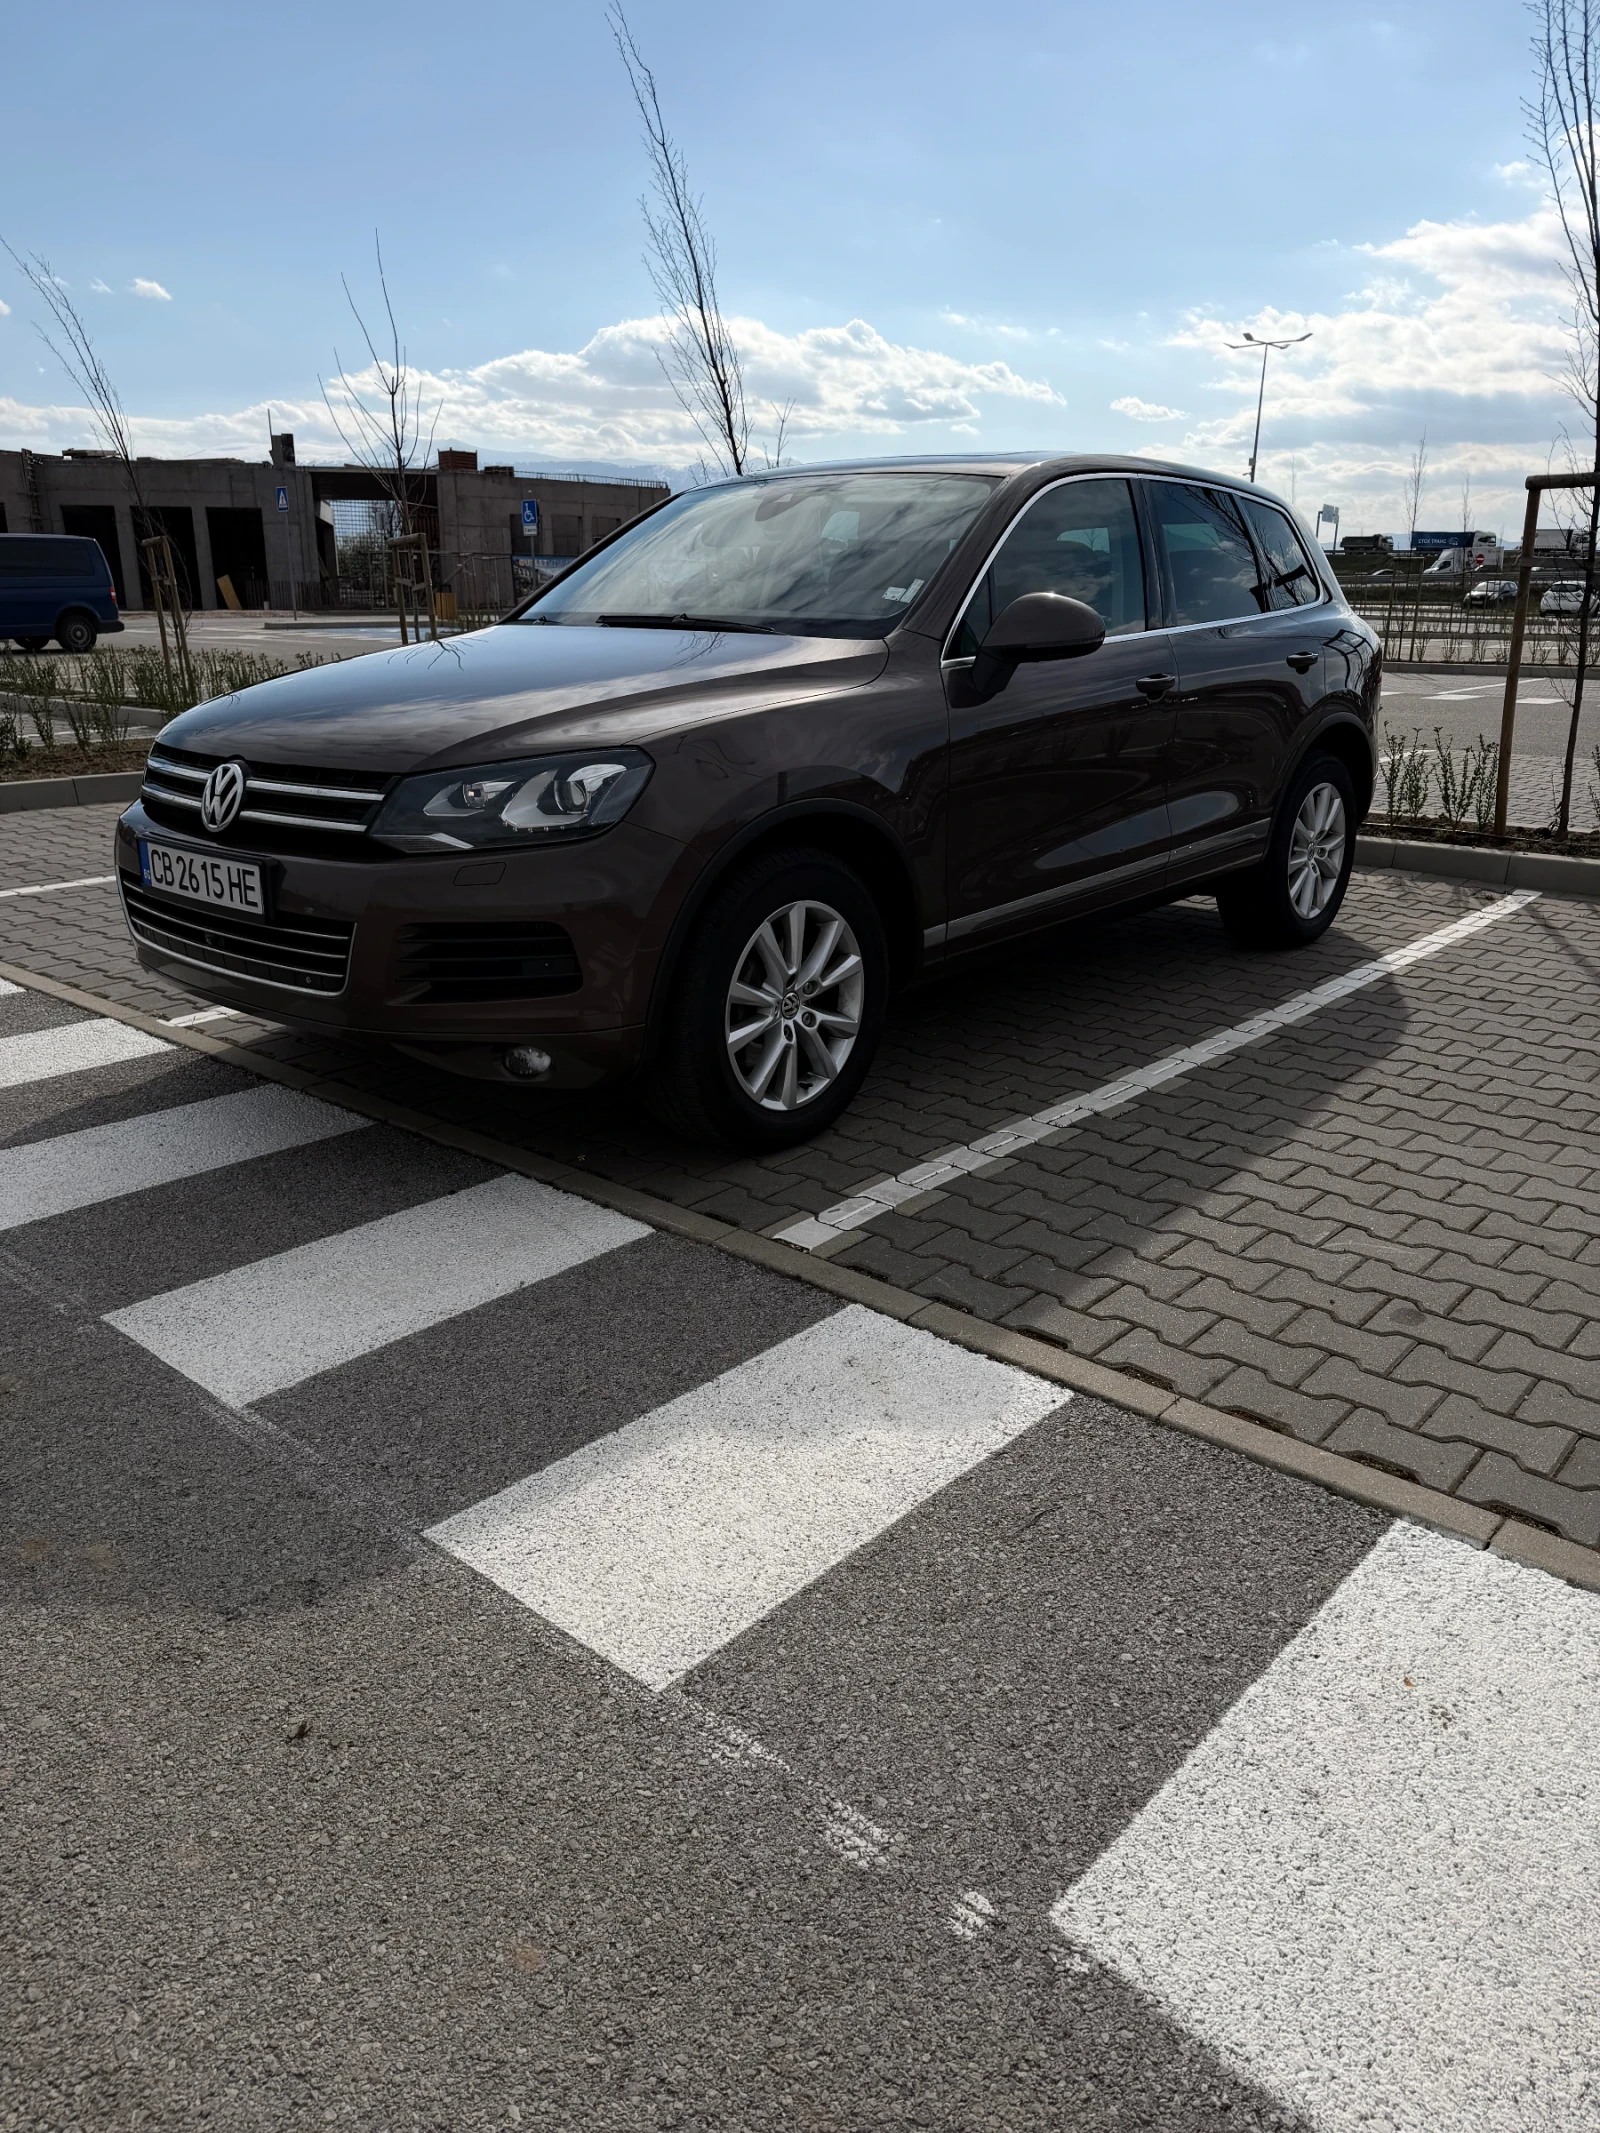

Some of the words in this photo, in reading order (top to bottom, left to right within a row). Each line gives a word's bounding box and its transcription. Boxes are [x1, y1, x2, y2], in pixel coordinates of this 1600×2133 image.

[151, 849, 174, 886] CB
[176, 856, 224, 899] 2615
[227, 866, 258, 907] HE
